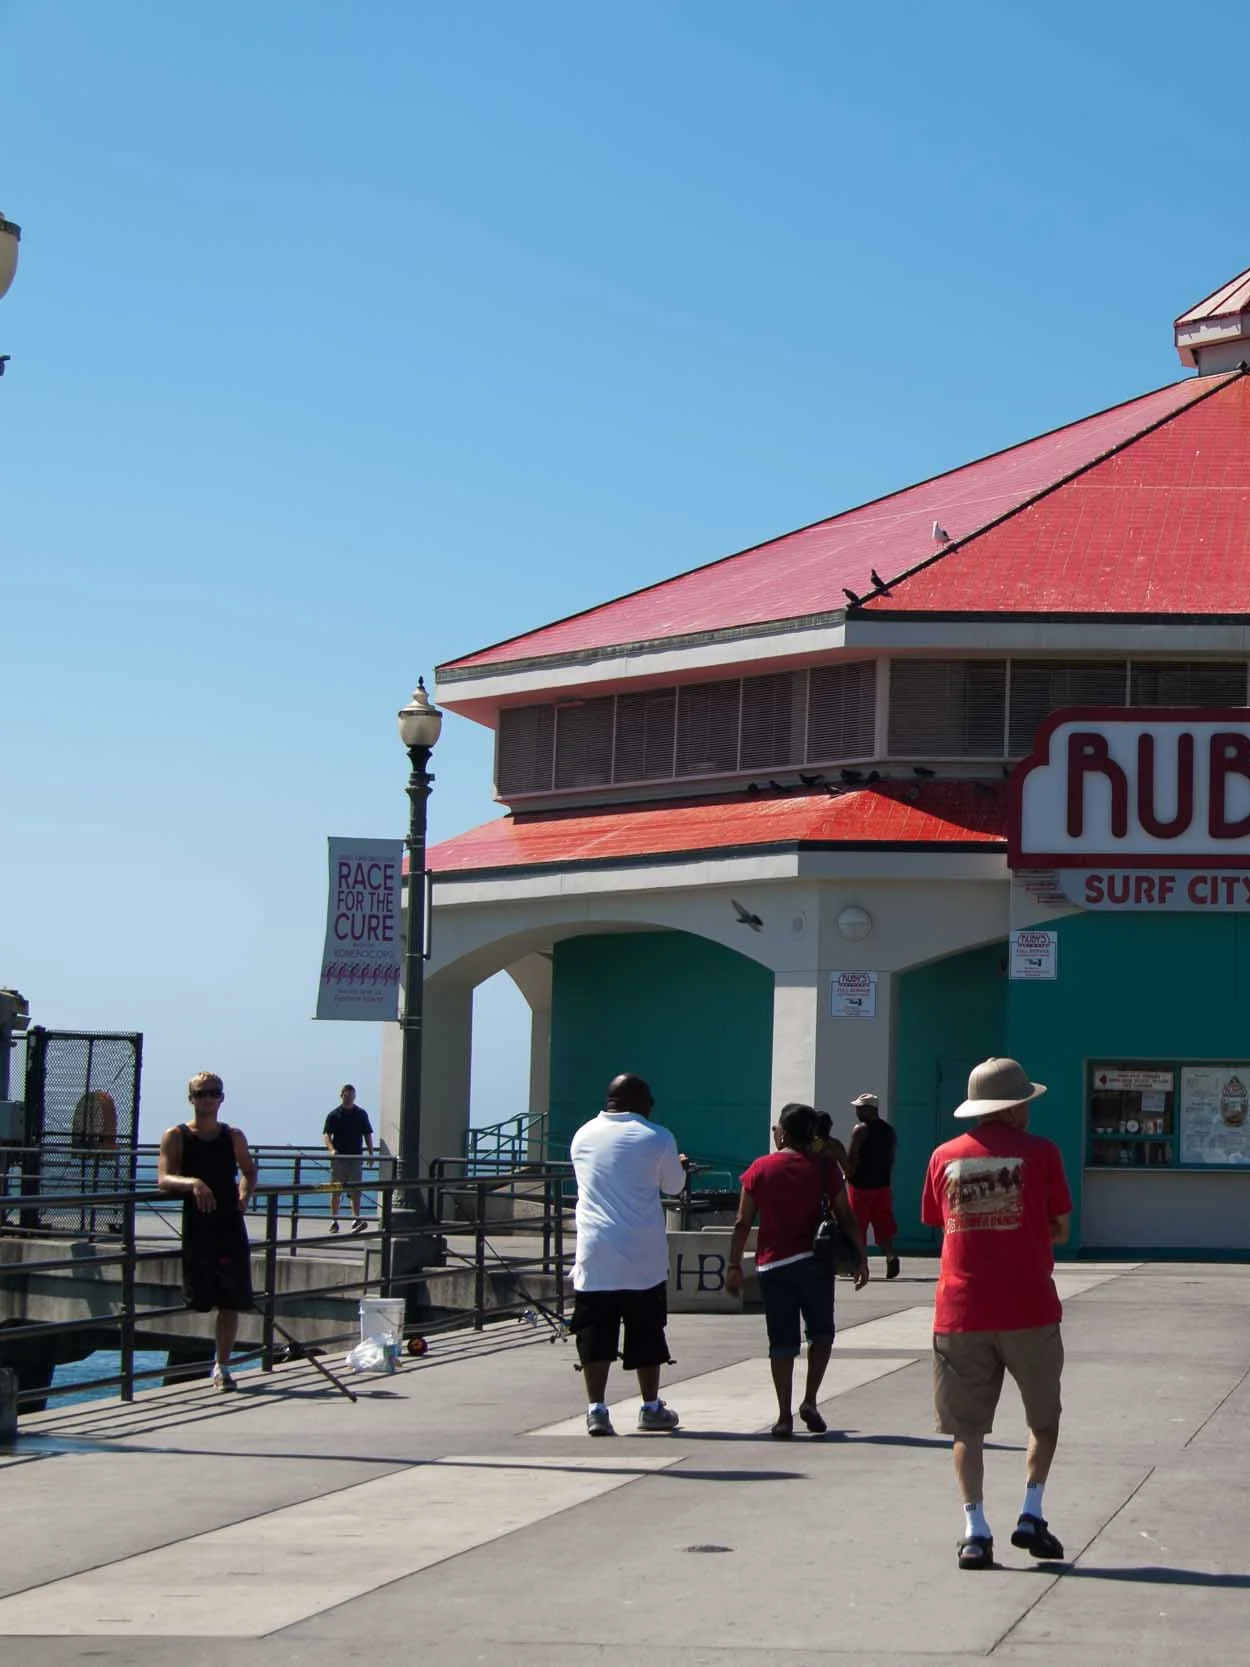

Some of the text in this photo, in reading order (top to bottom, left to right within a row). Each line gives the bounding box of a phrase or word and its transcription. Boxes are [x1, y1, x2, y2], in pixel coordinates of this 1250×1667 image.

[337, 861, 395, 891] RACE
[1085, 874, 1176, 905] SURF
[337, 891, 393, 912] FOR THE
[334, 913, 394, 942] CURE
[676, 1254, 726, 1291] HB
